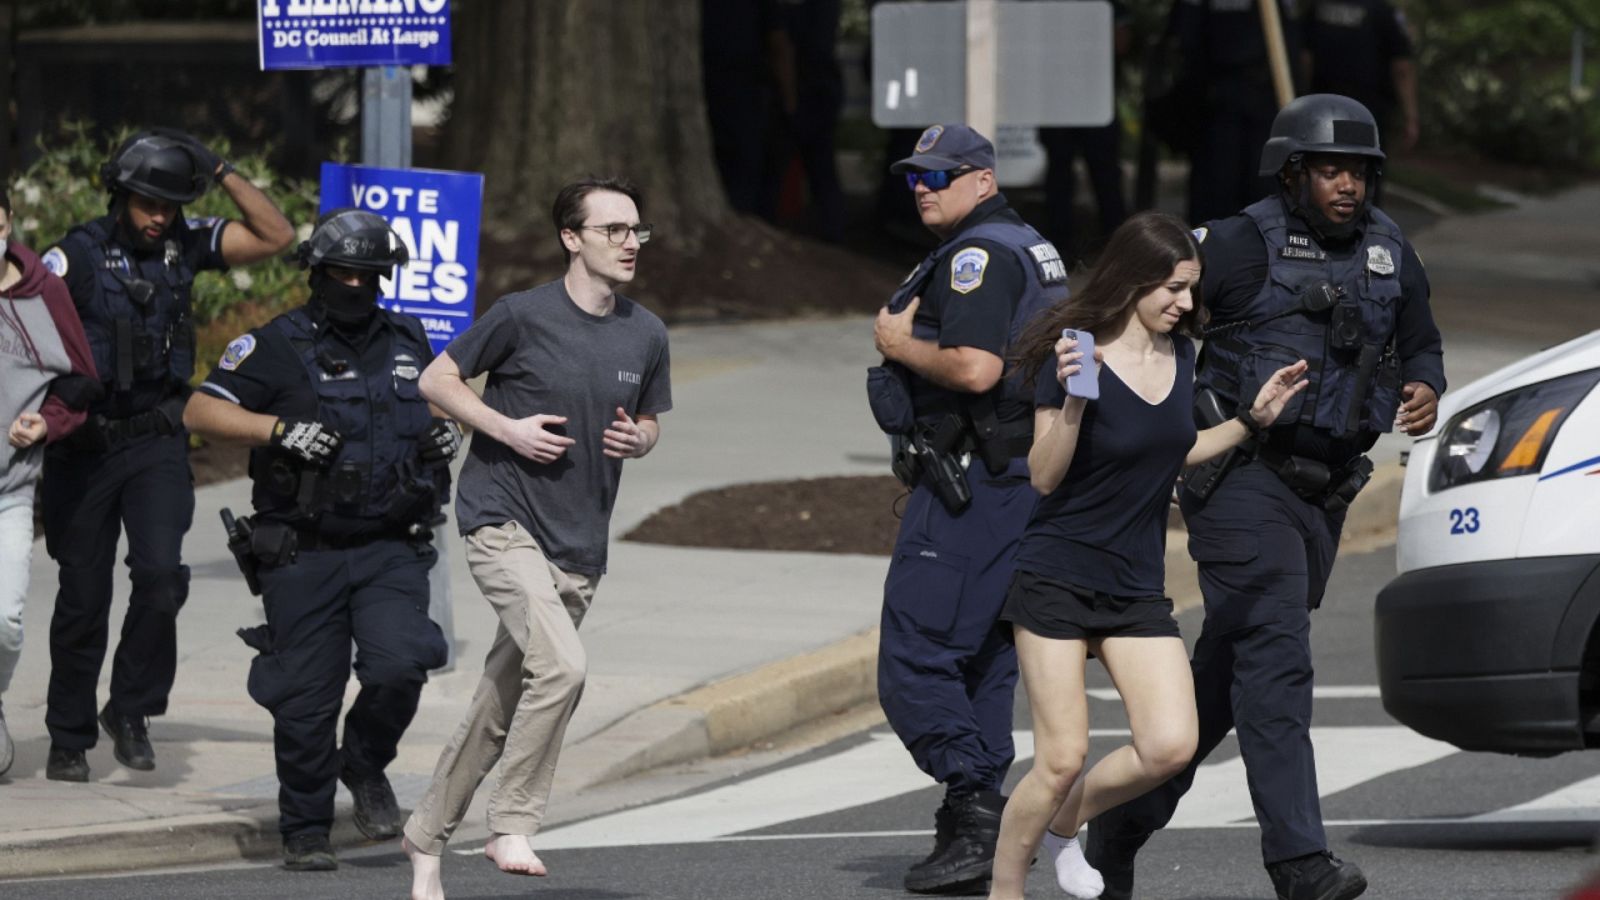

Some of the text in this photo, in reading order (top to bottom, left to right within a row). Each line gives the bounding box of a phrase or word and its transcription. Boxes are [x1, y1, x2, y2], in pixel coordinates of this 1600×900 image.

[273, 26, 440, 49] DC Council At Large
[352, 184, 440, 214] VOTE
[384, 215, 460, 263] AN
[379, 260, 468, 305] NES
[1450, 507, 1480, 535] 23
